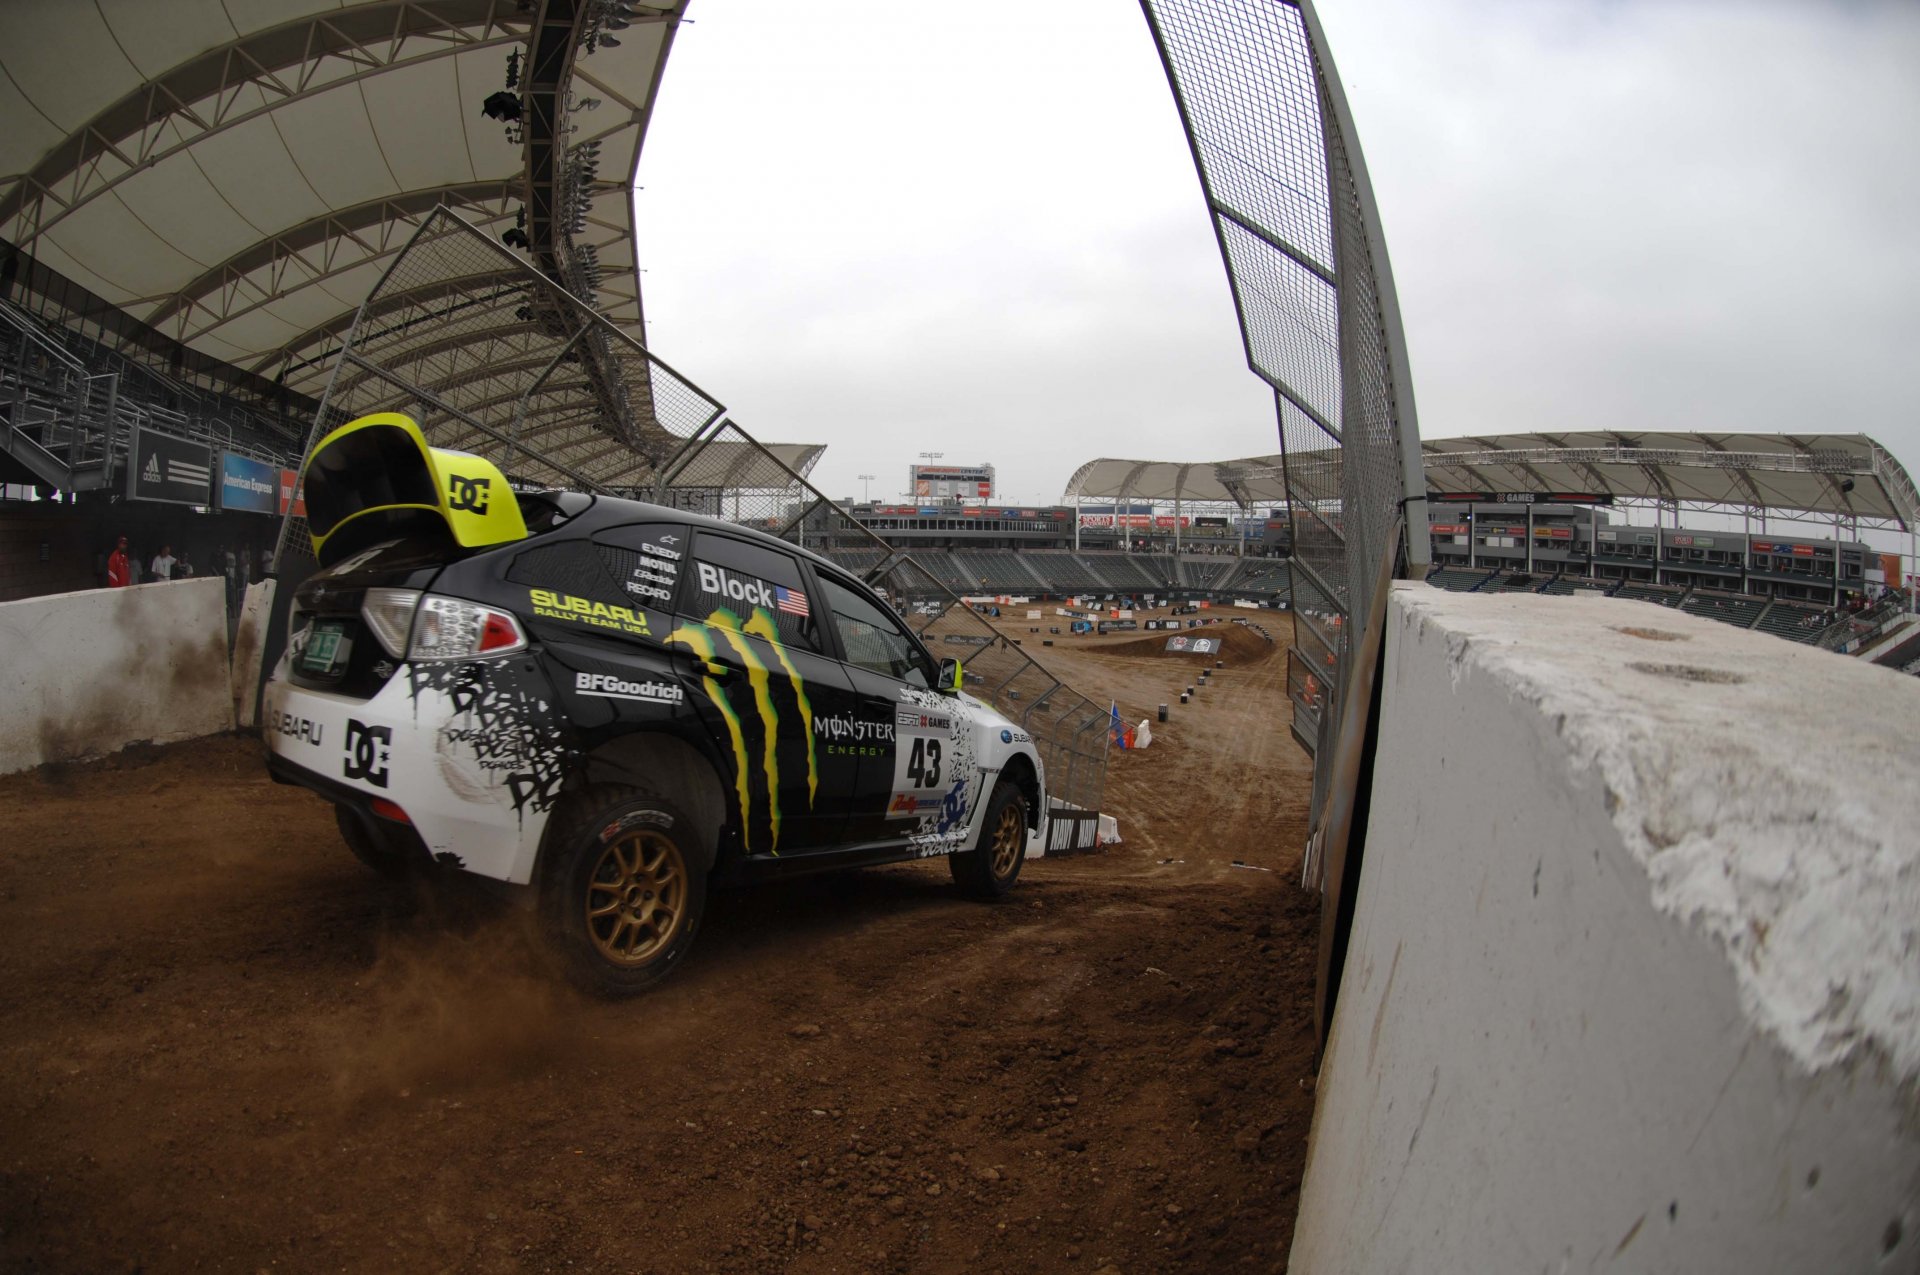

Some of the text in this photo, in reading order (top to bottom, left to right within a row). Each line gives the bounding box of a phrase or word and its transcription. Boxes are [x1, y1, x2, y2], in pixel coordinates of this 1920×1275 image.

[224, 472, 273, 495] American Express
[1507, 493, 1535, 503] GAMES
[640, 556, 677, 574] MOTUL
[642, 543, 681, 560] EXEDY
[627, 581, 671, 601] RECARO
[698, 562, 774, 609] Block
[529, 589, 647, 626] SUBARU
[533, 606, 652, 636] RALLY TEAM USA
[576, 672, 683, 700] BFGoodrich
[272, 709, 324, 746] SUBARU
[814, 710, 896, 742] MONSTER
[929, 717, 950, 730] GAMES
[827, 745, 886, 757] ENERGY
[907, 737, 942, 789] 43
[1050, 818, 1098, 851] NAVY NAVY
